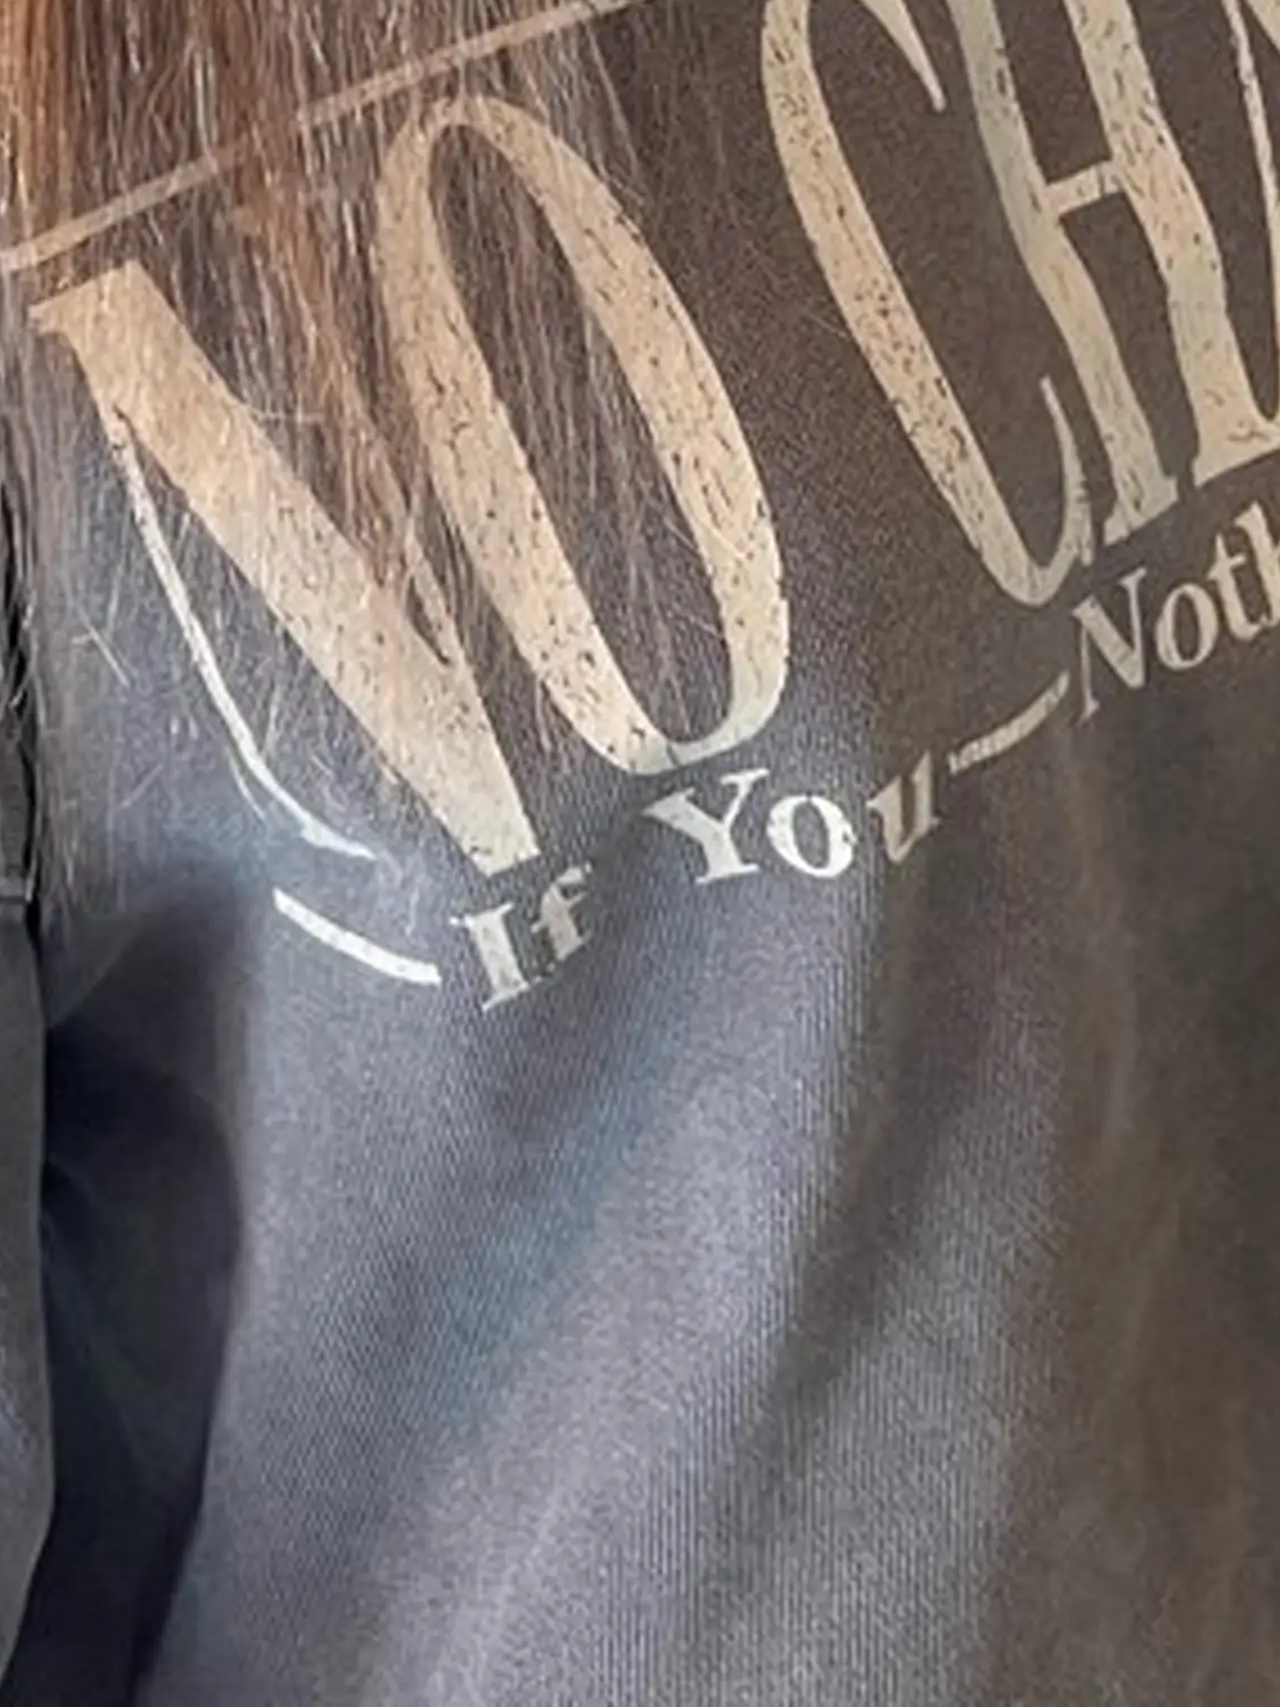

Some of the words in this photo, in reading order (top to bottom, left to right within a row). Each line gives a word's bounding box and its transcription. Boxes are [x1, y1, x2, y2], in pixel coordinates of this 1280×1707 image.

[28, 94, 791, 877] NO
[449, 861, 594, 1013] If
[642, 751, 939, 885] You
